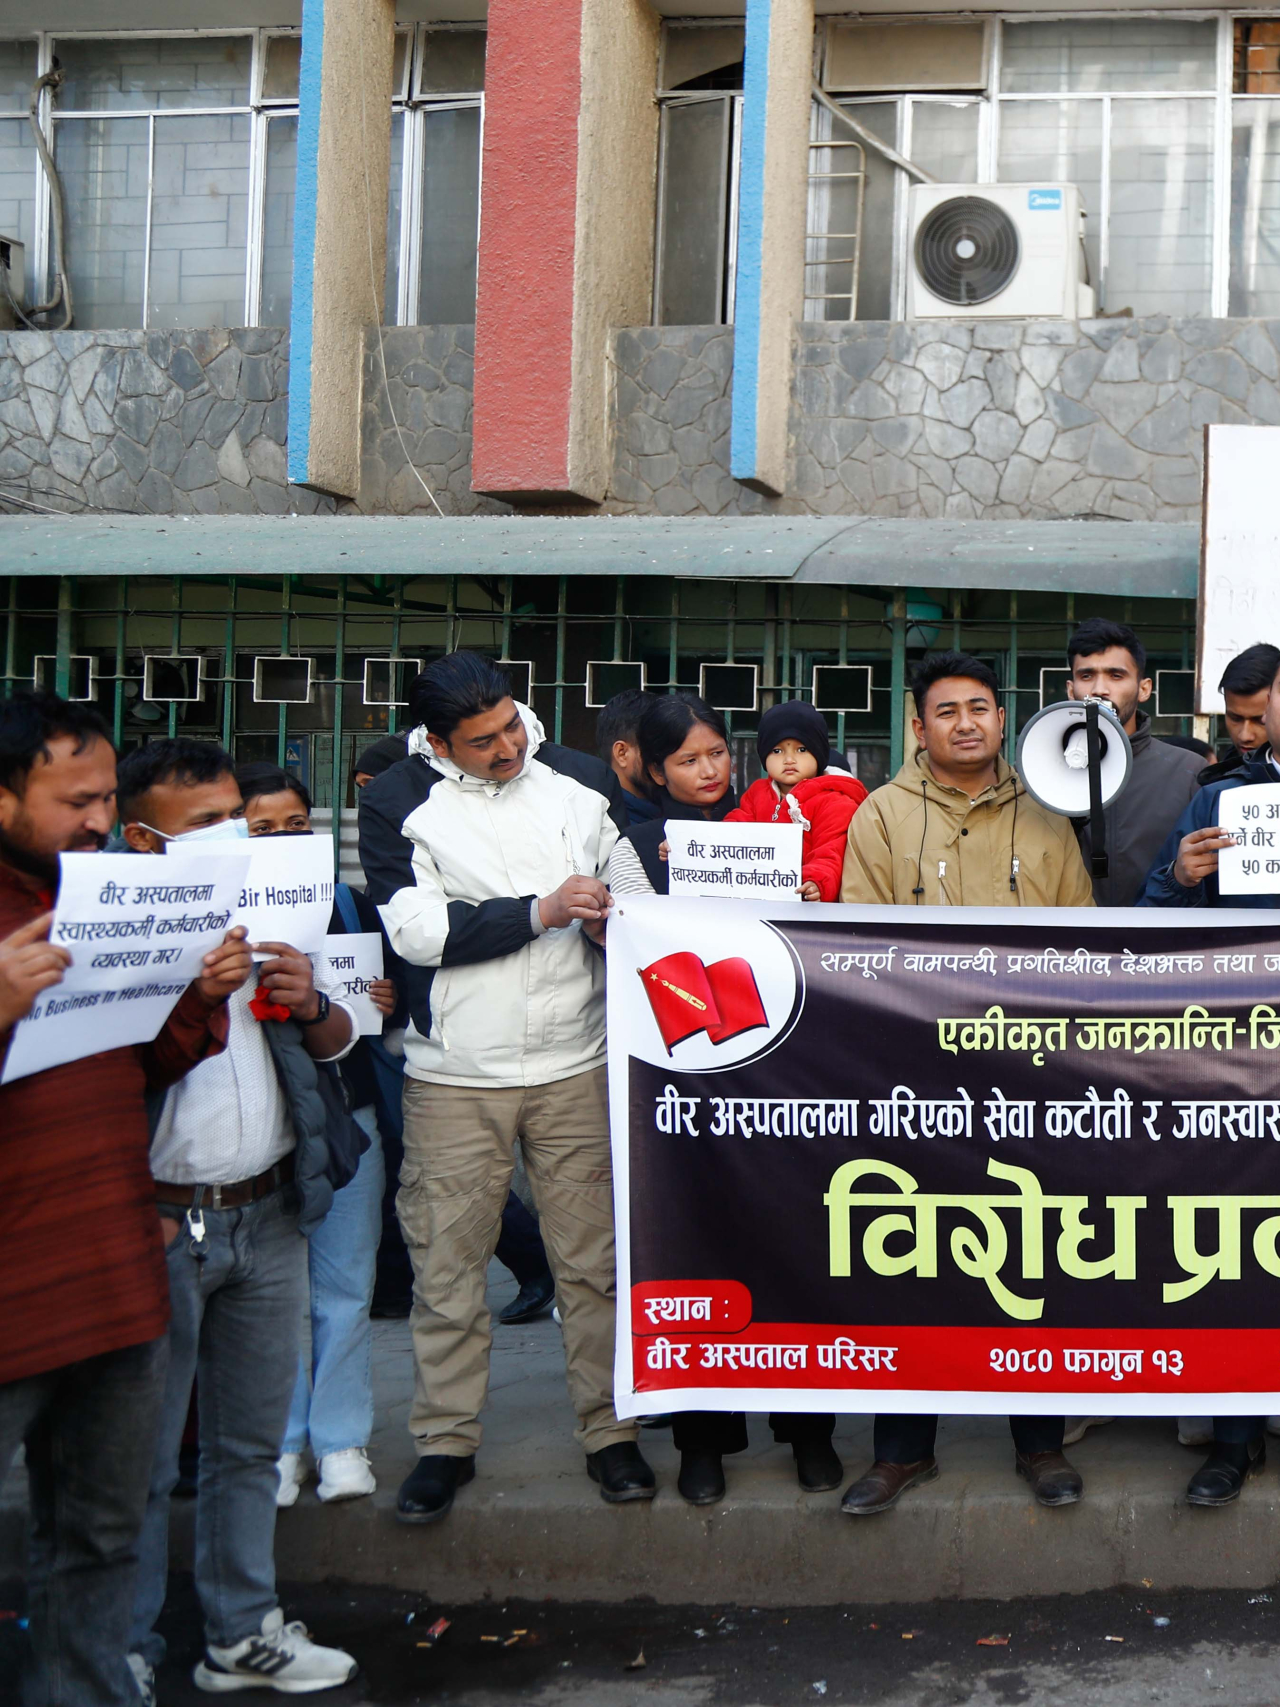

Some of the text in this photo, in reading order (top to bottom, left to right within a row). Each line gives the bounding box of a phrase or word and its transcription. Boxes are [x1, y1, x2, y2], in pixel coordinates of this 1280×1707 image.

[1242, 804, 1260, 821] ५०
[686, 839, 776, 861] वीर अस्पतालमा
[1251, 826, 1276, 848] वीर
[735, 868, 799, 888] कर्मचारीको
[1241, 859, 1260, 876] ५०
[98, 880, 216, 907] वीर अस्पतालमा
[238, 883, 332, 908] Bir Hospital !!!
[155, 909, 232, 935] कर्मचारीको
[89, 949, 151, 969] व्यवस्था
[819, 946, 898, 980] सम्पूर्ण
[1120, 947, 1205, 976] देशभक्त
[1213, 952, 1255, 975] तथा
[45, 993, 98, 1017] Business
[102, 990, 115, 1005] In
[119, 983, 185, 1001] Healthcare
[937, 1004, 1070, 1067] एकीकृत
[654, 1083, 702, 1139] वीर
[708, 1096, 861, 1142] अस्पतालमा
[868, 1084, 975, 1140] गरिएको
[982, 1086, 1036, 1142] सेवा
[1044, 1085, 1134, 1140] कटौती
[1141, 1100, 1164, 1143] र
[823, 1158, 1149, 1322] विरोध
[643, 1295, 713, 1324] स्थान
[646, 1337, 900, 1371] वीर अस्पताल परिसर
[988, 1349, 1186, 1381] २०८० फागुन १३
